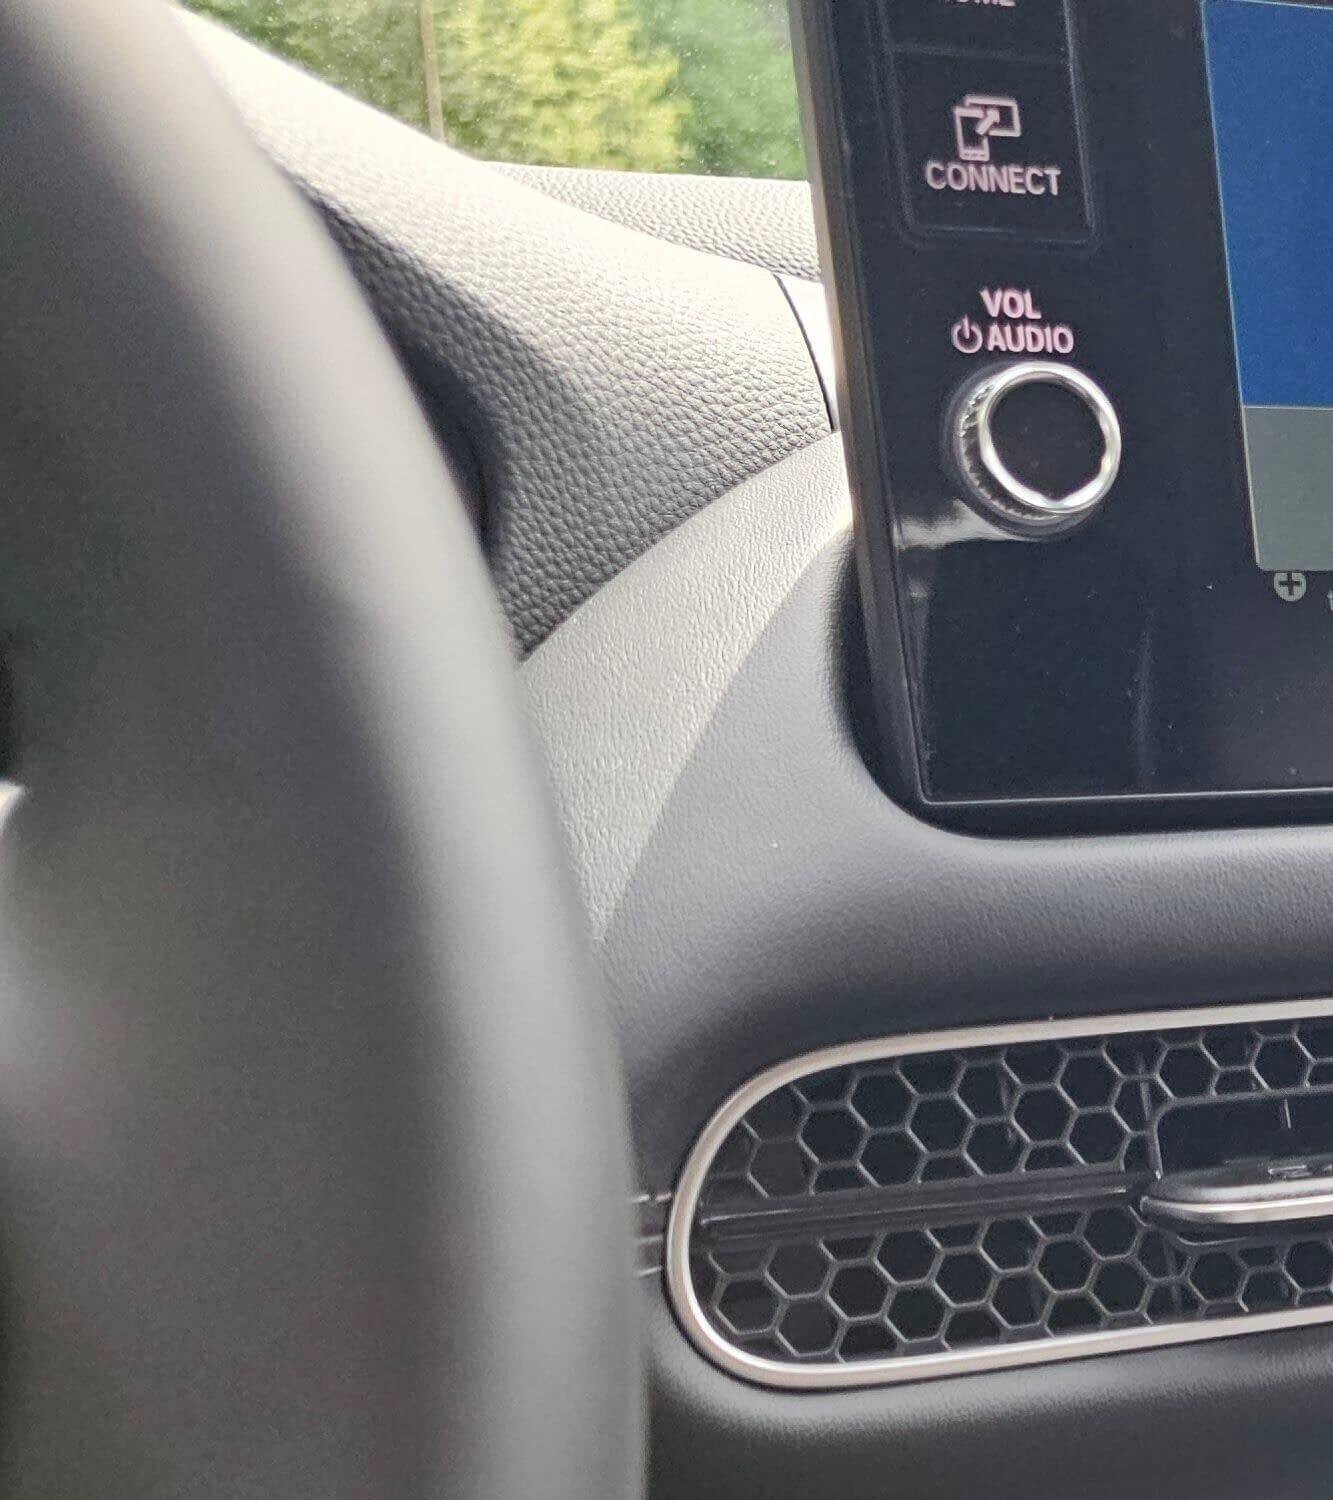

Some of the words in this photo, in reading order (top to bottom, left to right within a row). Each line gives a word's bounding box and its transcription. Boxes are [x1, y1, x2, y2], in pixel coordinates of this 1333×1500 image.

[925, 160, 1061, 196] CONNECT
[979, 285, 1042, 320] VOL
[987, 321, 1074, 354] AUDIO
